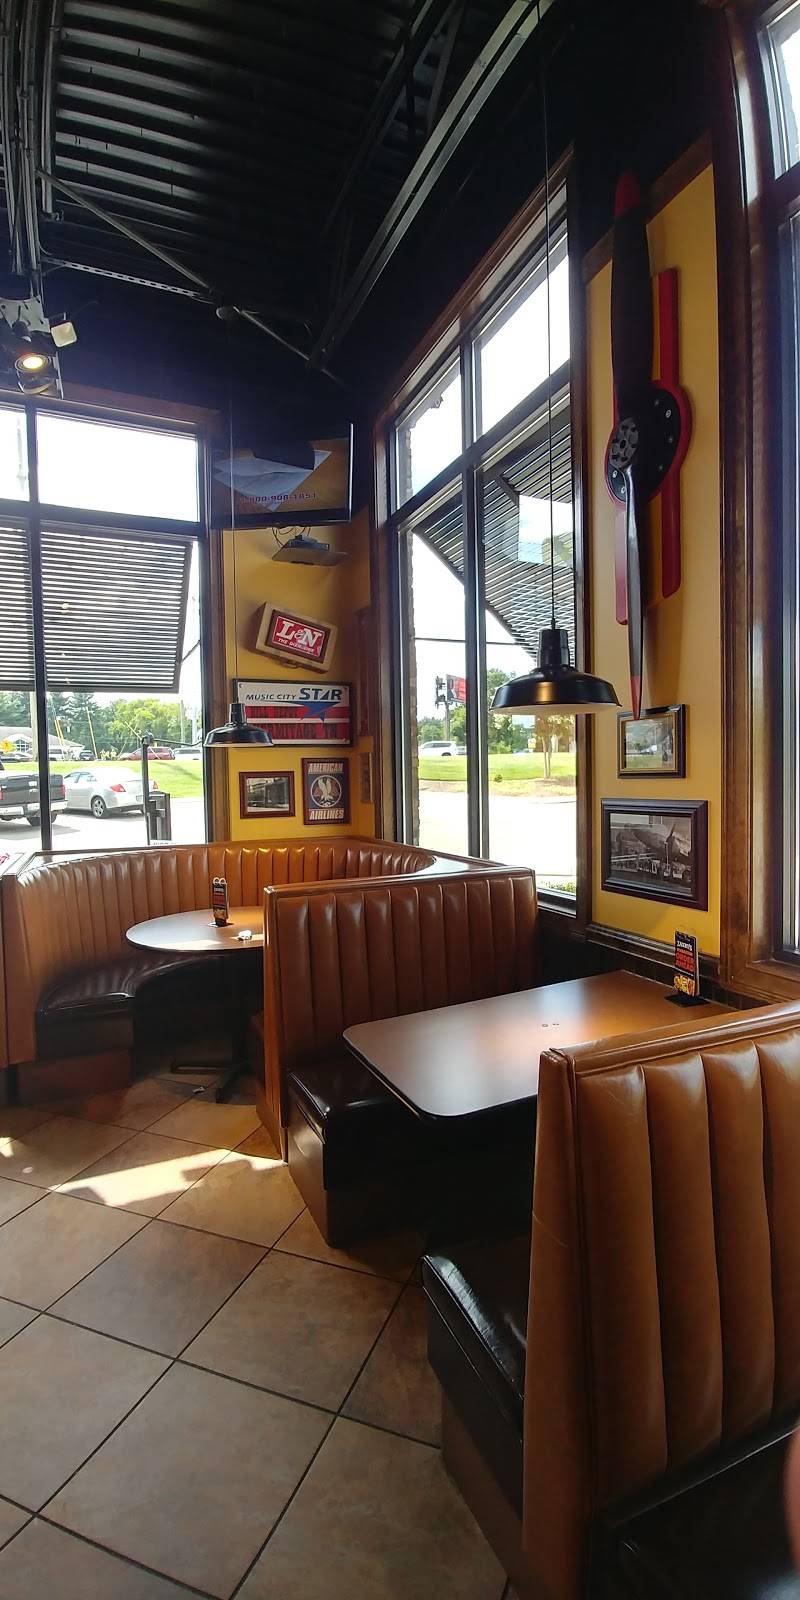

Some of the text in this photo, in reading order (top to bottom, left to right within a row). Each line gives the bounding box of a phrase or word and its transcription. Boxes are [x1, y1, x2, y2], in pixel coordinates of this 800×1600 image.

[276, 621, 322, 647] L&N
[299, 688, 342, 700] STAR
[308, 762, 343, 773] AMERICAN
[309, 809, 344, 820] AIRLINES
